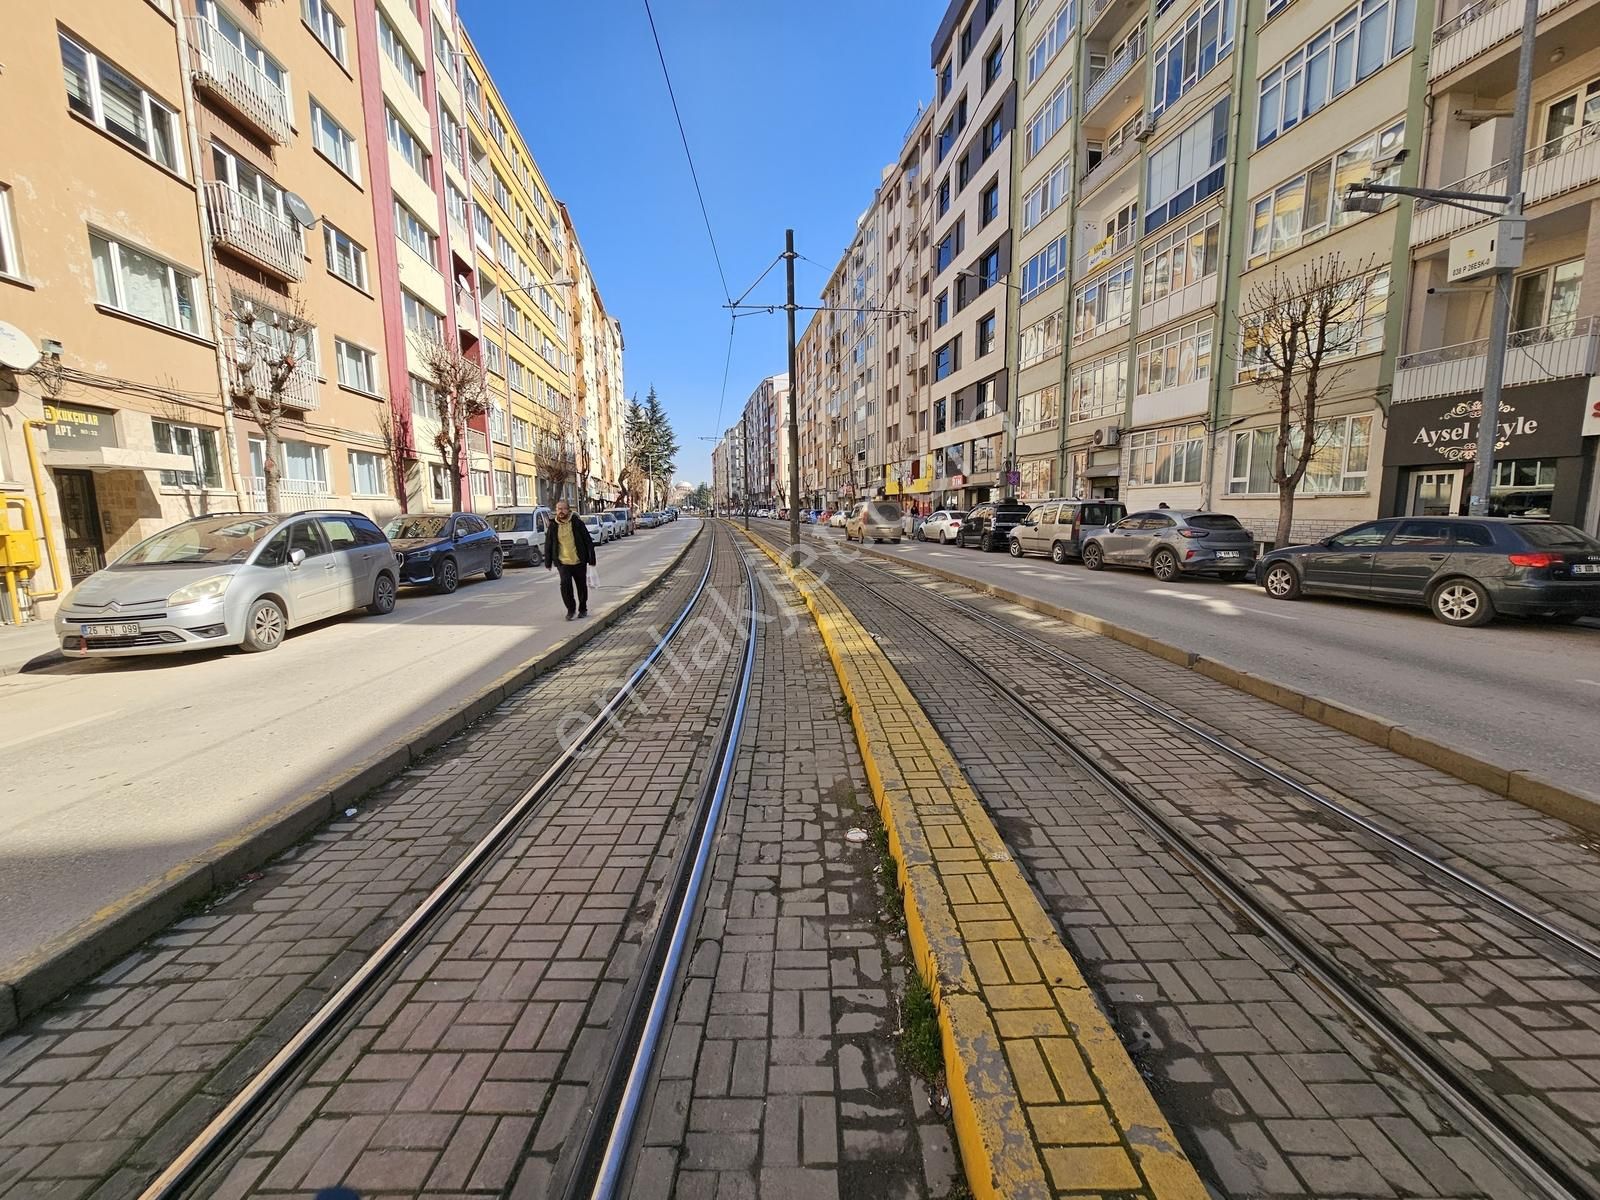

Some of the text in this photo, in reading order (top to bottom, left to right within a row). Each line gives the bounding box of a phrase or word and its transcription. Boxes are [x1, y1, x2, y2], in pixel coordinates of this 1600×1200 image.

[55, 424, 76, 438] APT.
[1412, 421, 1470, 448] Aysel
[88, 626, 98, 635] 26
[104, 625, 116, 634] FH
